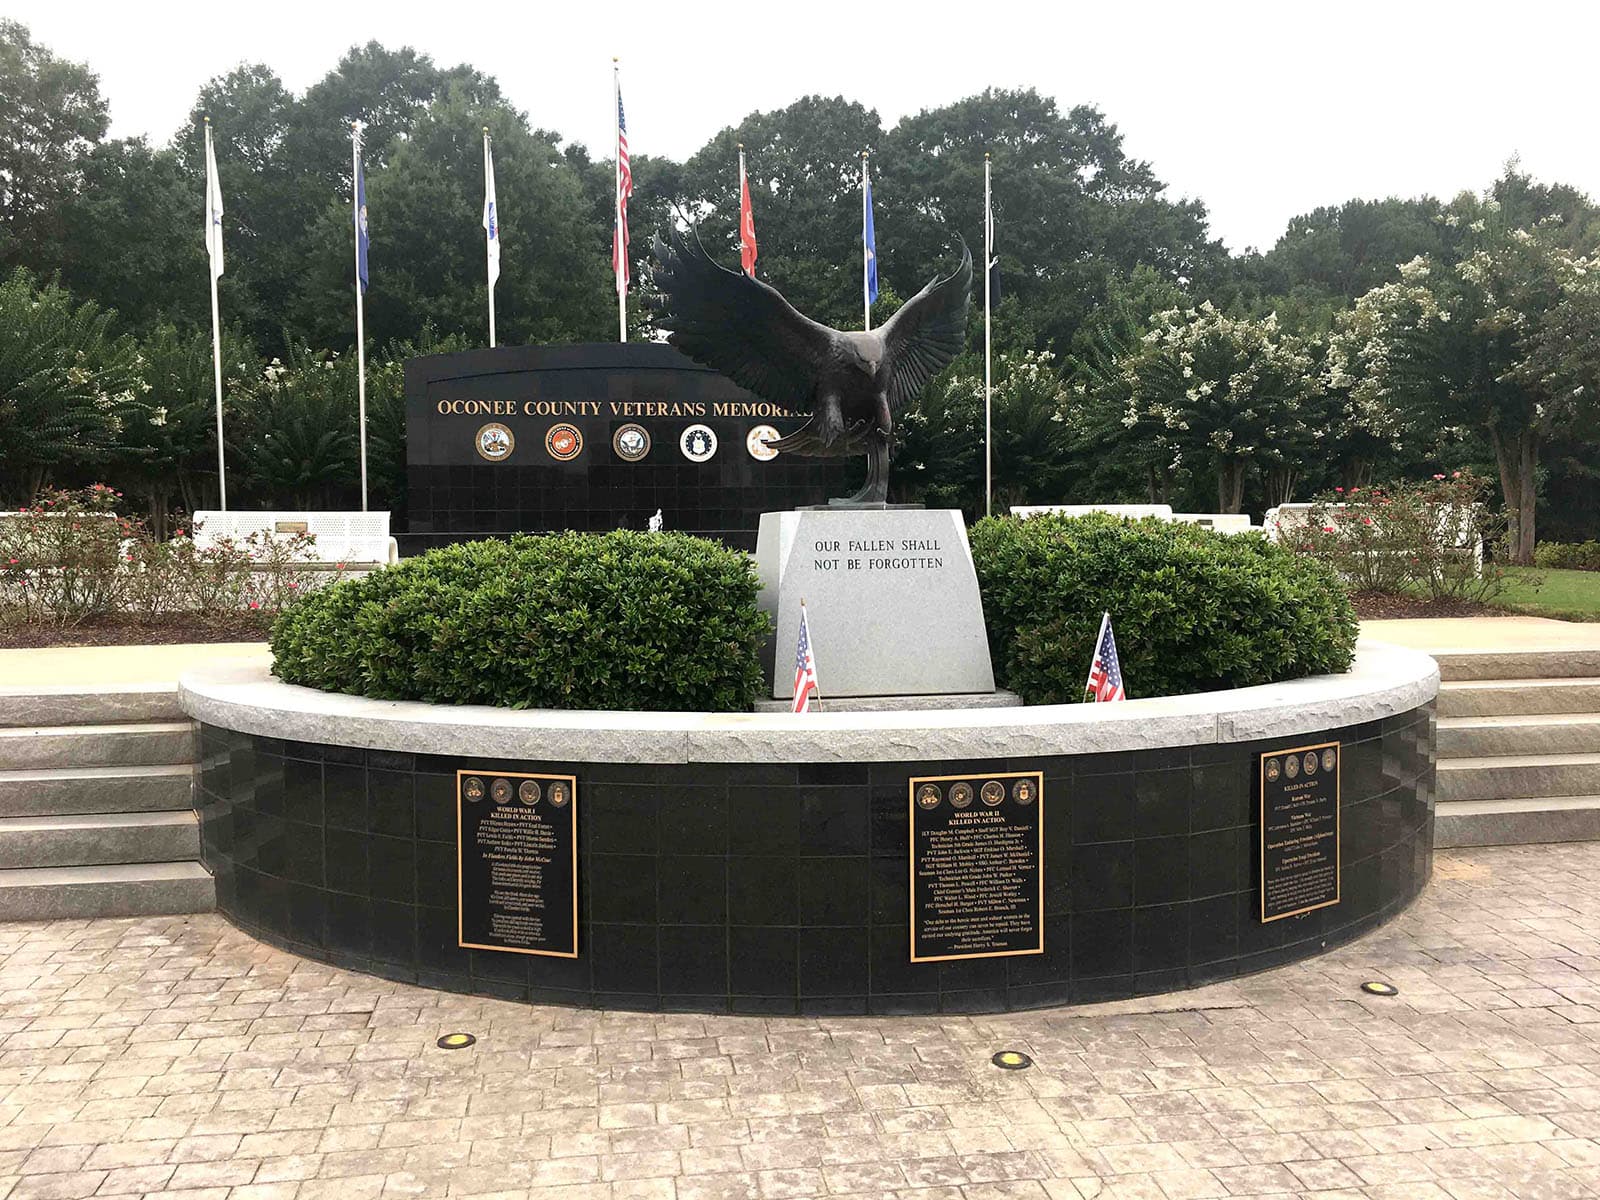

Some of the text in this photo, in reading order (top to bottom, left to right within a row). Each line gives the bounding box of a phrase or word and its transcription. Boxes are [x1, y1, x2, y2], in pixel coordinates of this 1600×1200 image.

[437, 399, 814, 417] OCONEE COUNTY VETERANS MEMORI
[815, 539, 941, 552] OUR FALLEN SHALL
[814, 557, 943, 571] NOT BE FORGOTTEN
[948, 818, 973, 826] KILLED
[981, 816, 1006, 824] ACTION
